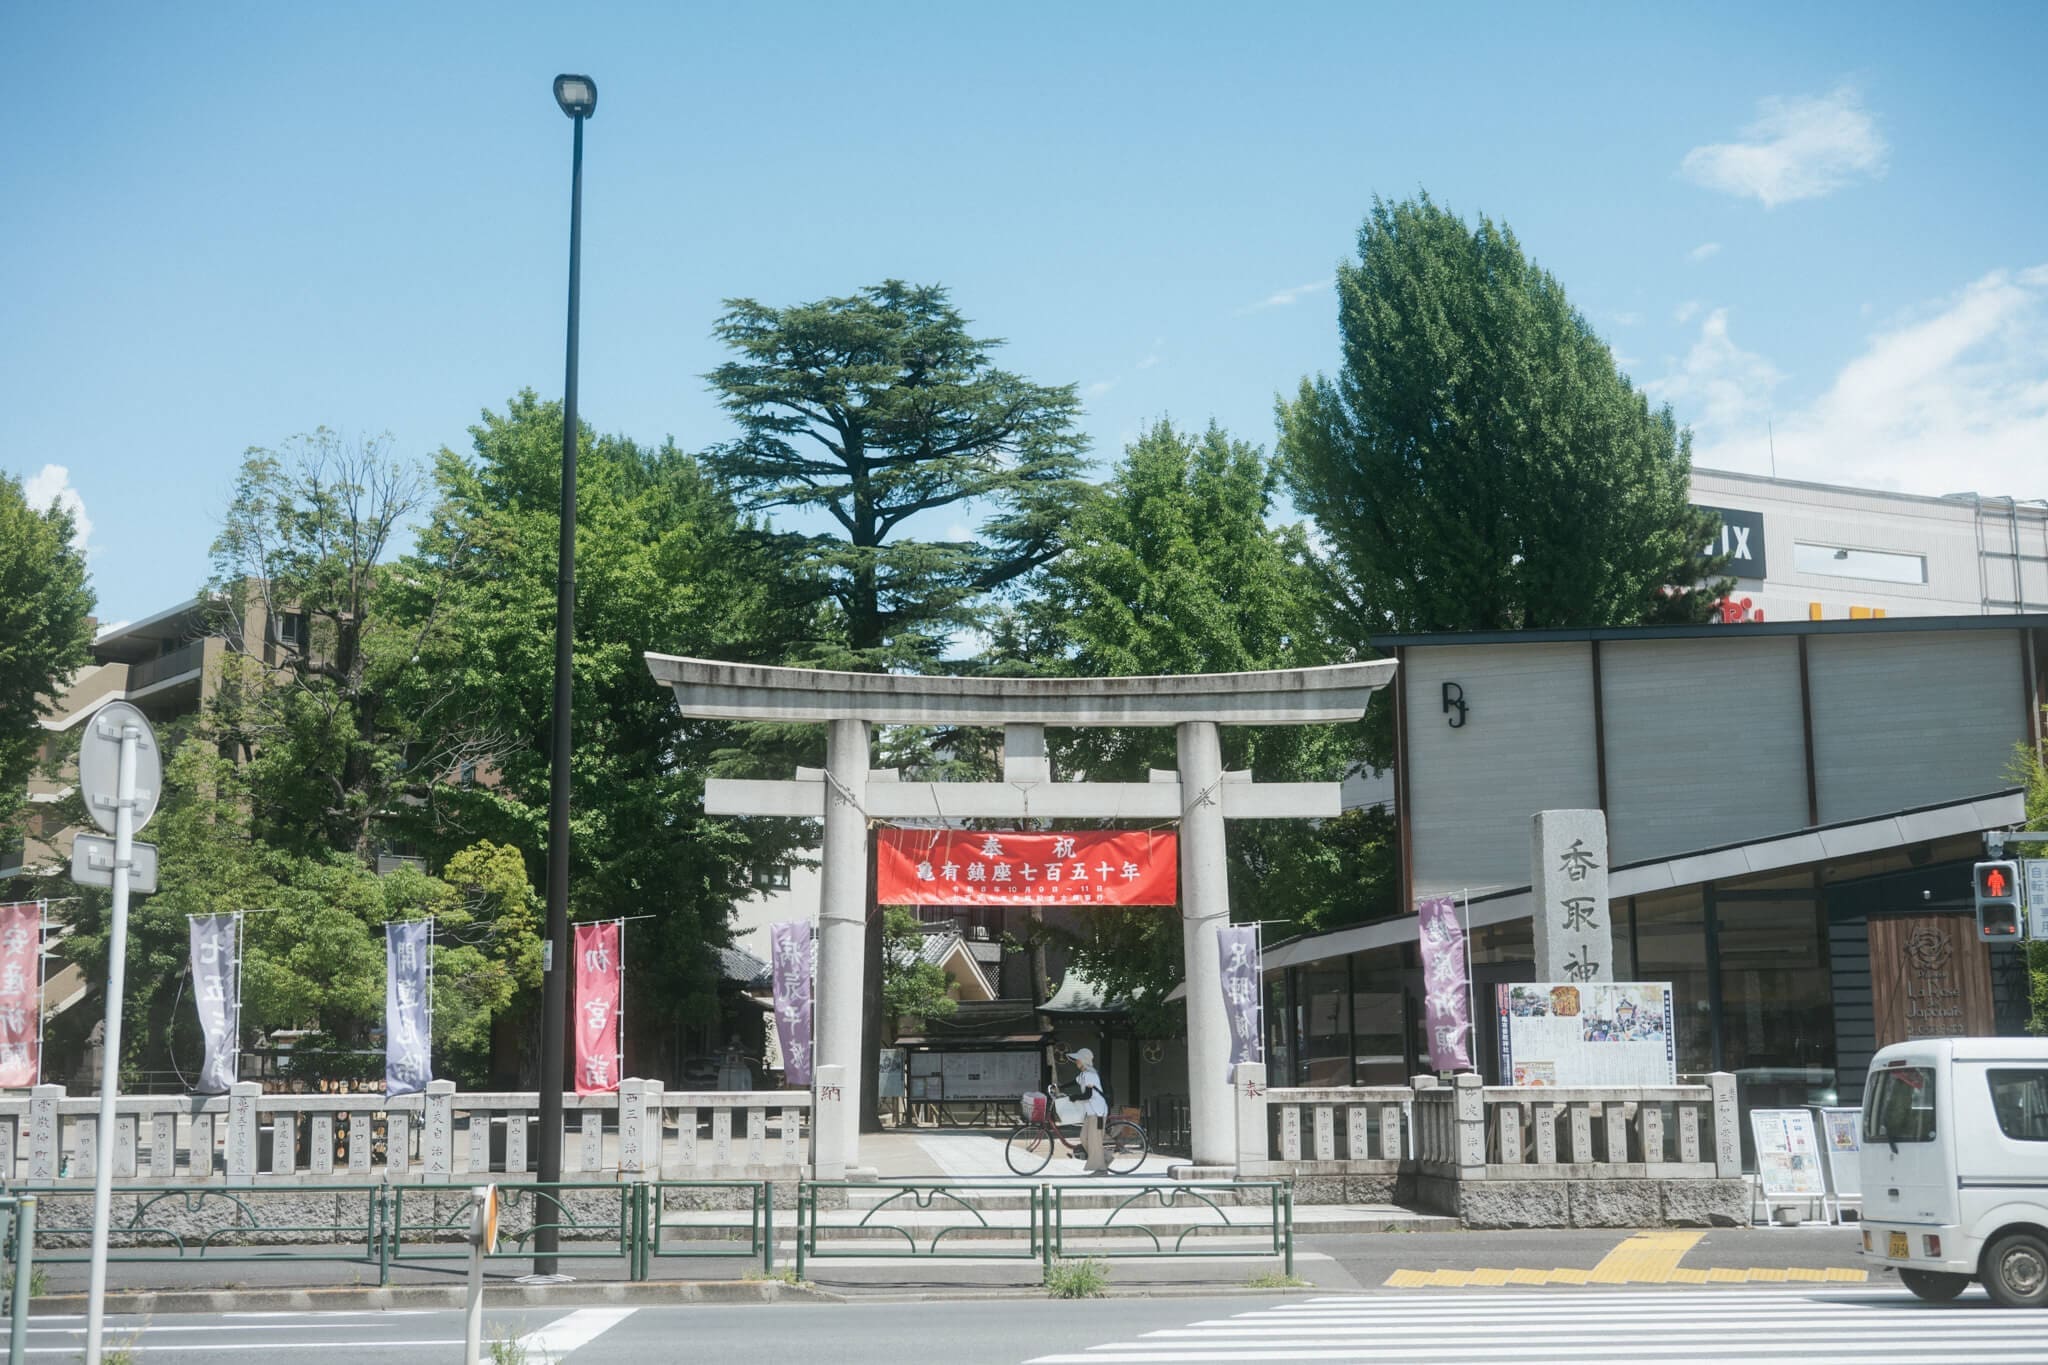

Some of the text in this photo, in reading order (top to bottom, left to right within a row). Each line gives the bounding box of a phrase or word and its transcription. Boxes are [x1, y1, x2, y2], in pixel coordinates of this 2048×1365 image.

[1704, 524, 1752, 560] IX
[916, 862, 1141, 883] 亀有鎮座七百五十年
[1243, 1079, 1264, 1101] 奉
